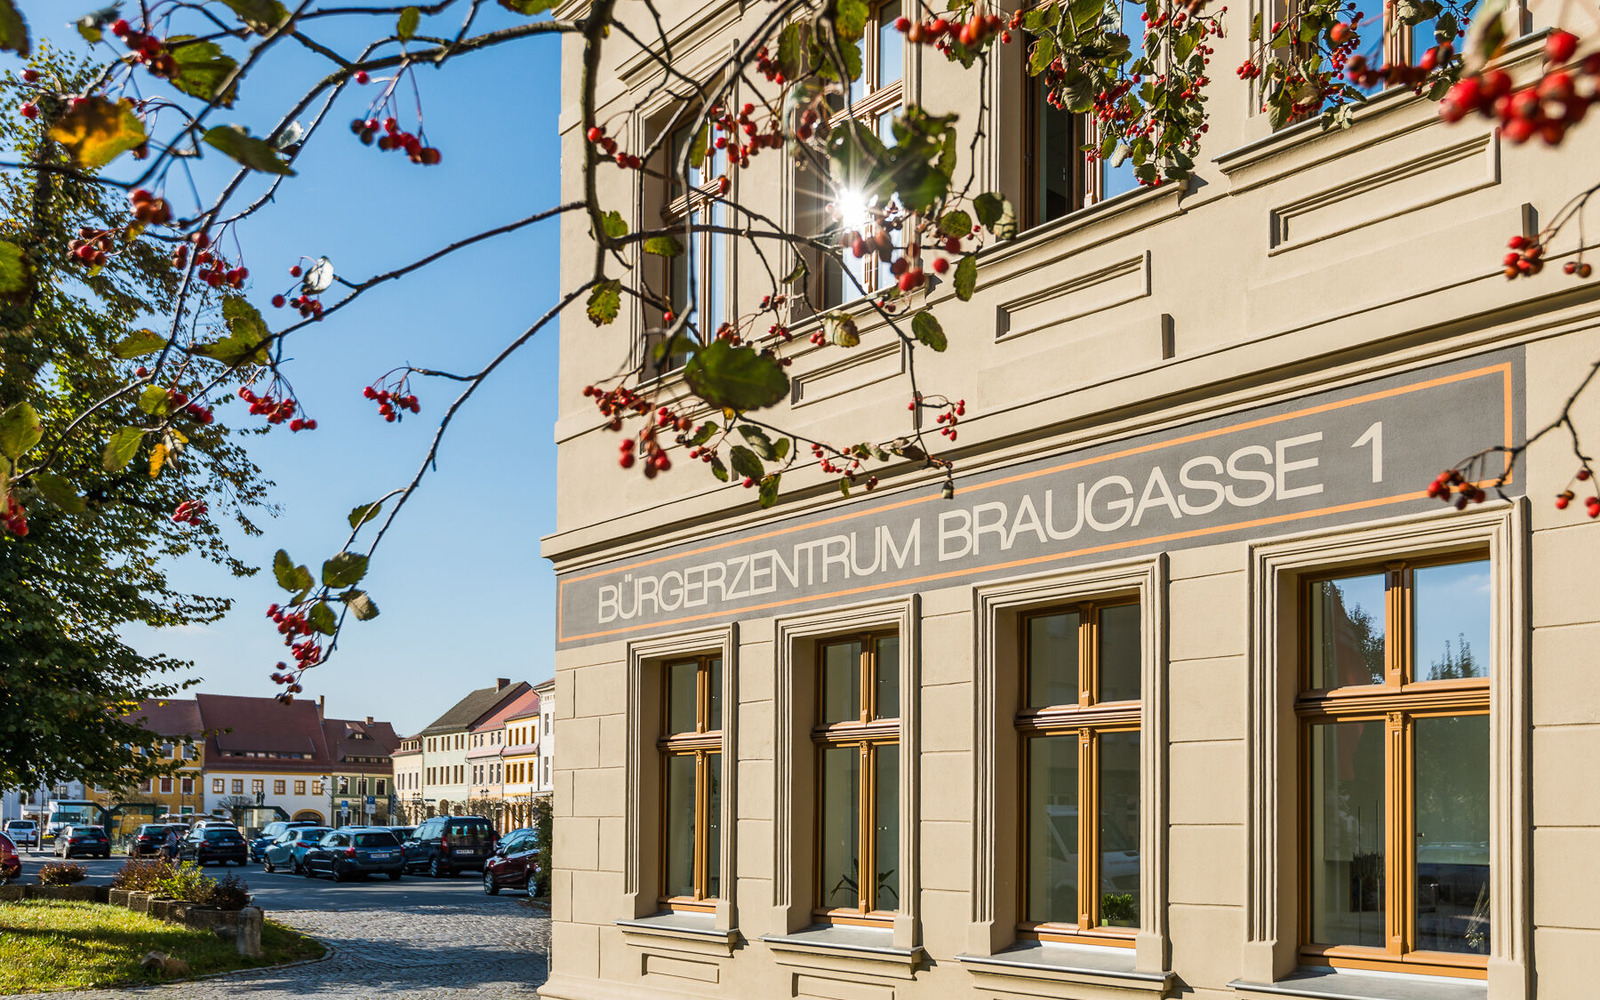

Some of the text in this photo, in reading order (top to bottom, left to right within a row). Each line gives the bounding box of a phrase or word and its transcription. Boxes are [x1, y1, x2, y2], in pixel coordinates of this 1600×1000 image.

[598, 421, 1383, 624] BÜRGERZENTRUM BRAUGASSE 1
